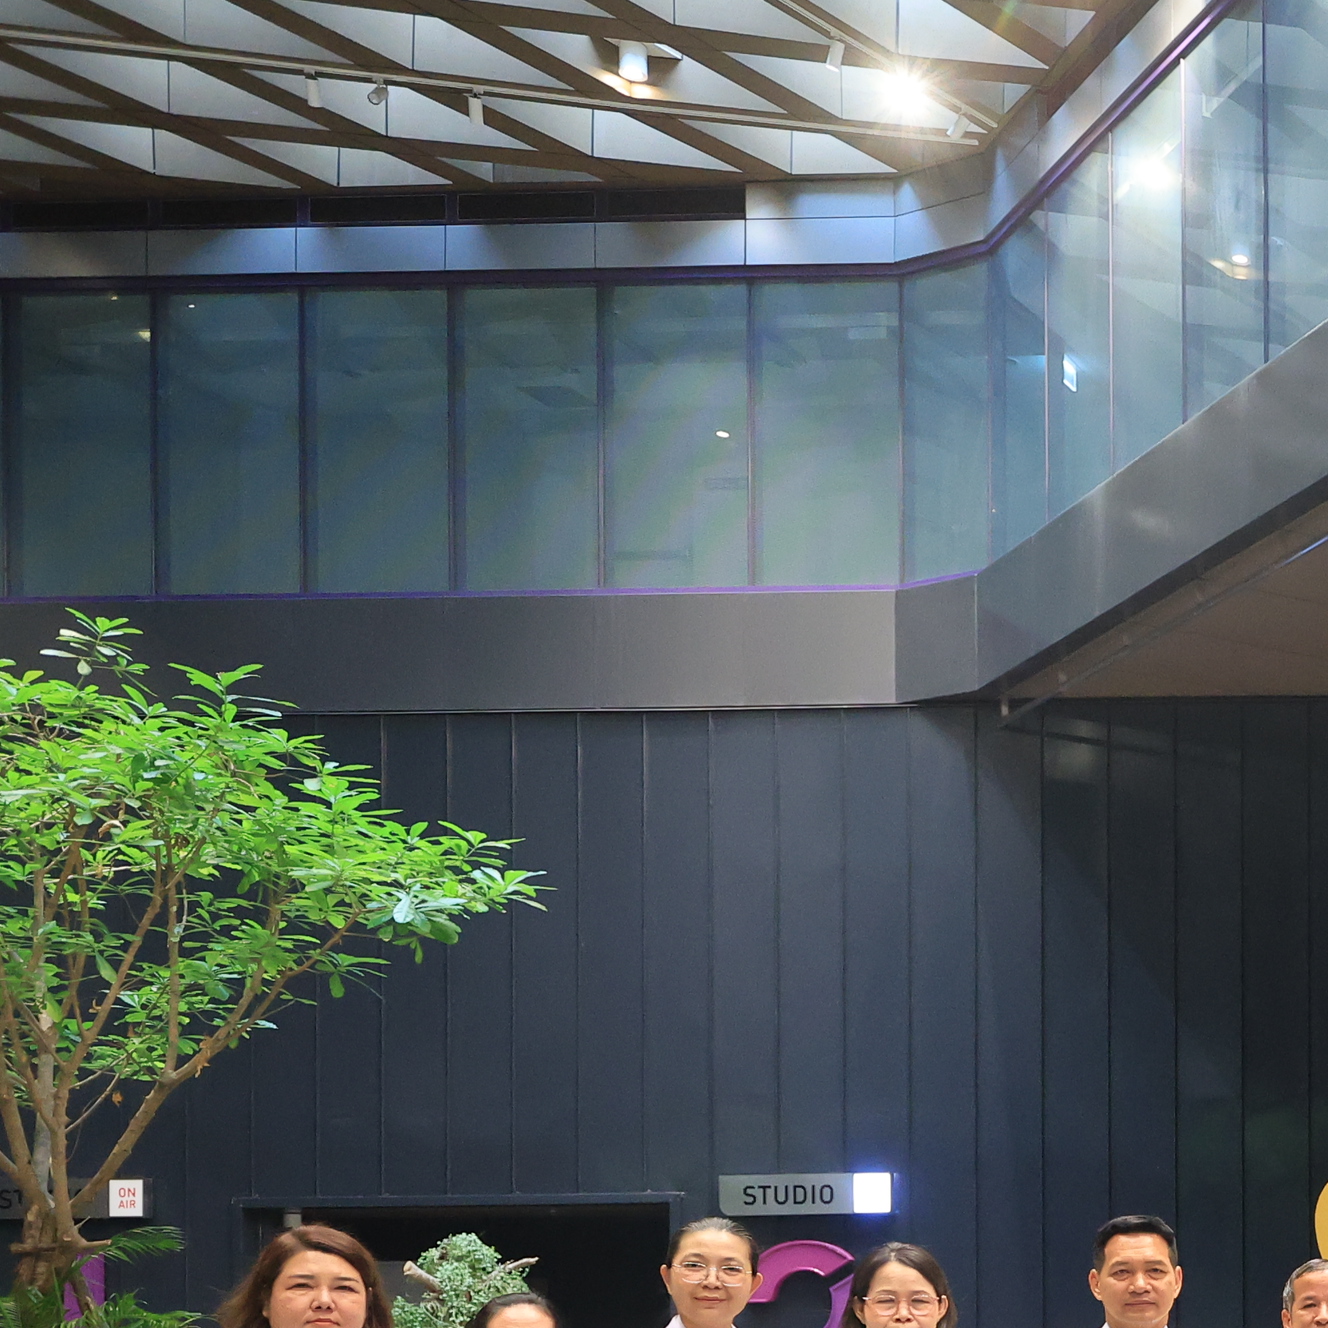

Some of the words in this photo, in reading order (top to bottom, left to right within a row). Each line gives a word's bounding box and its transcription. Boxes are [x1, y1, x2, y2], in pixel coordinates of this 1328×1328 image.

[118, 1187, 136, 1198] ON
[743, 1184, 834, 1205] STUDIO
[118, 1200, 136, 1209] AIR
